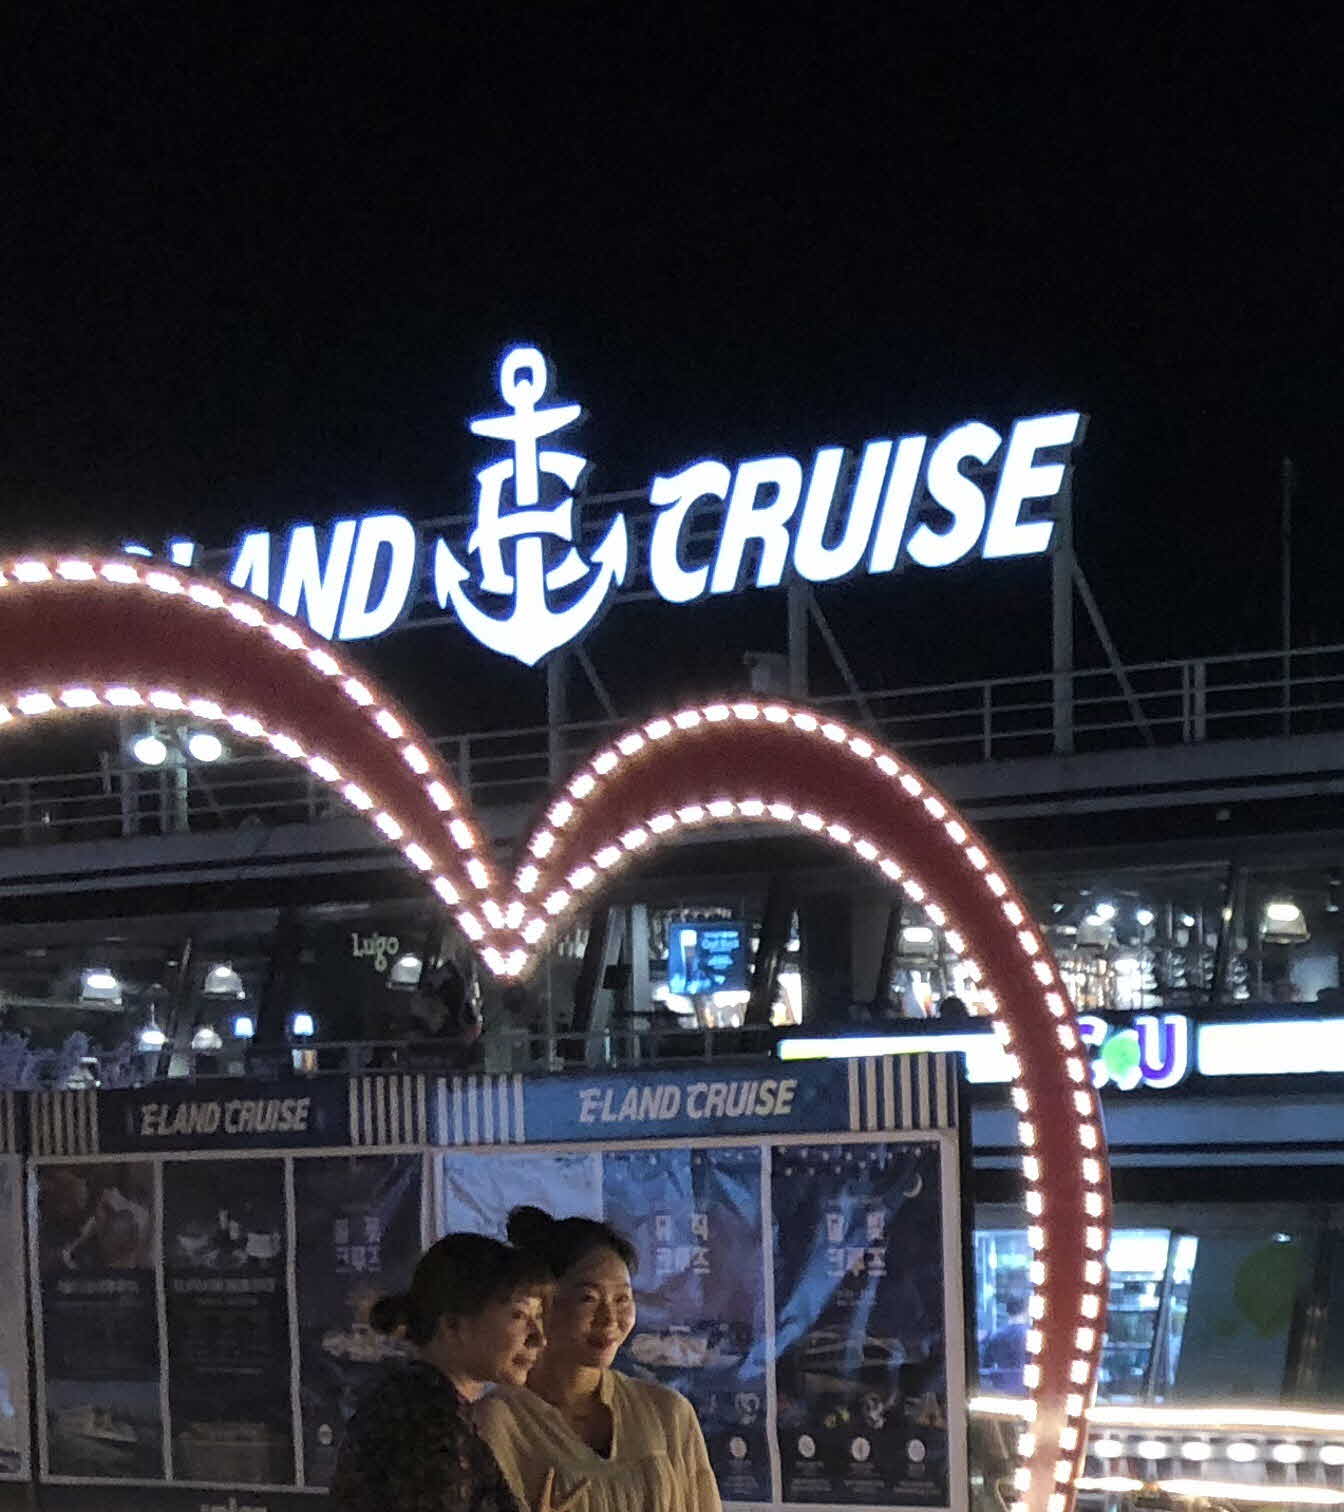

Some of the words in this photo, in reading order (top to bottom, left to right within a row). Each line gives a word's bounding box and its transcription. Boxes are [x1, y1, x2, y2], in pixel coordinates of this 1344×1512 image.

[649, 411, 1081, 604] CRUISE
[223, 1098, 312, 1134] CRUISE
[685, 1078, 799, 1119] CRUISE
